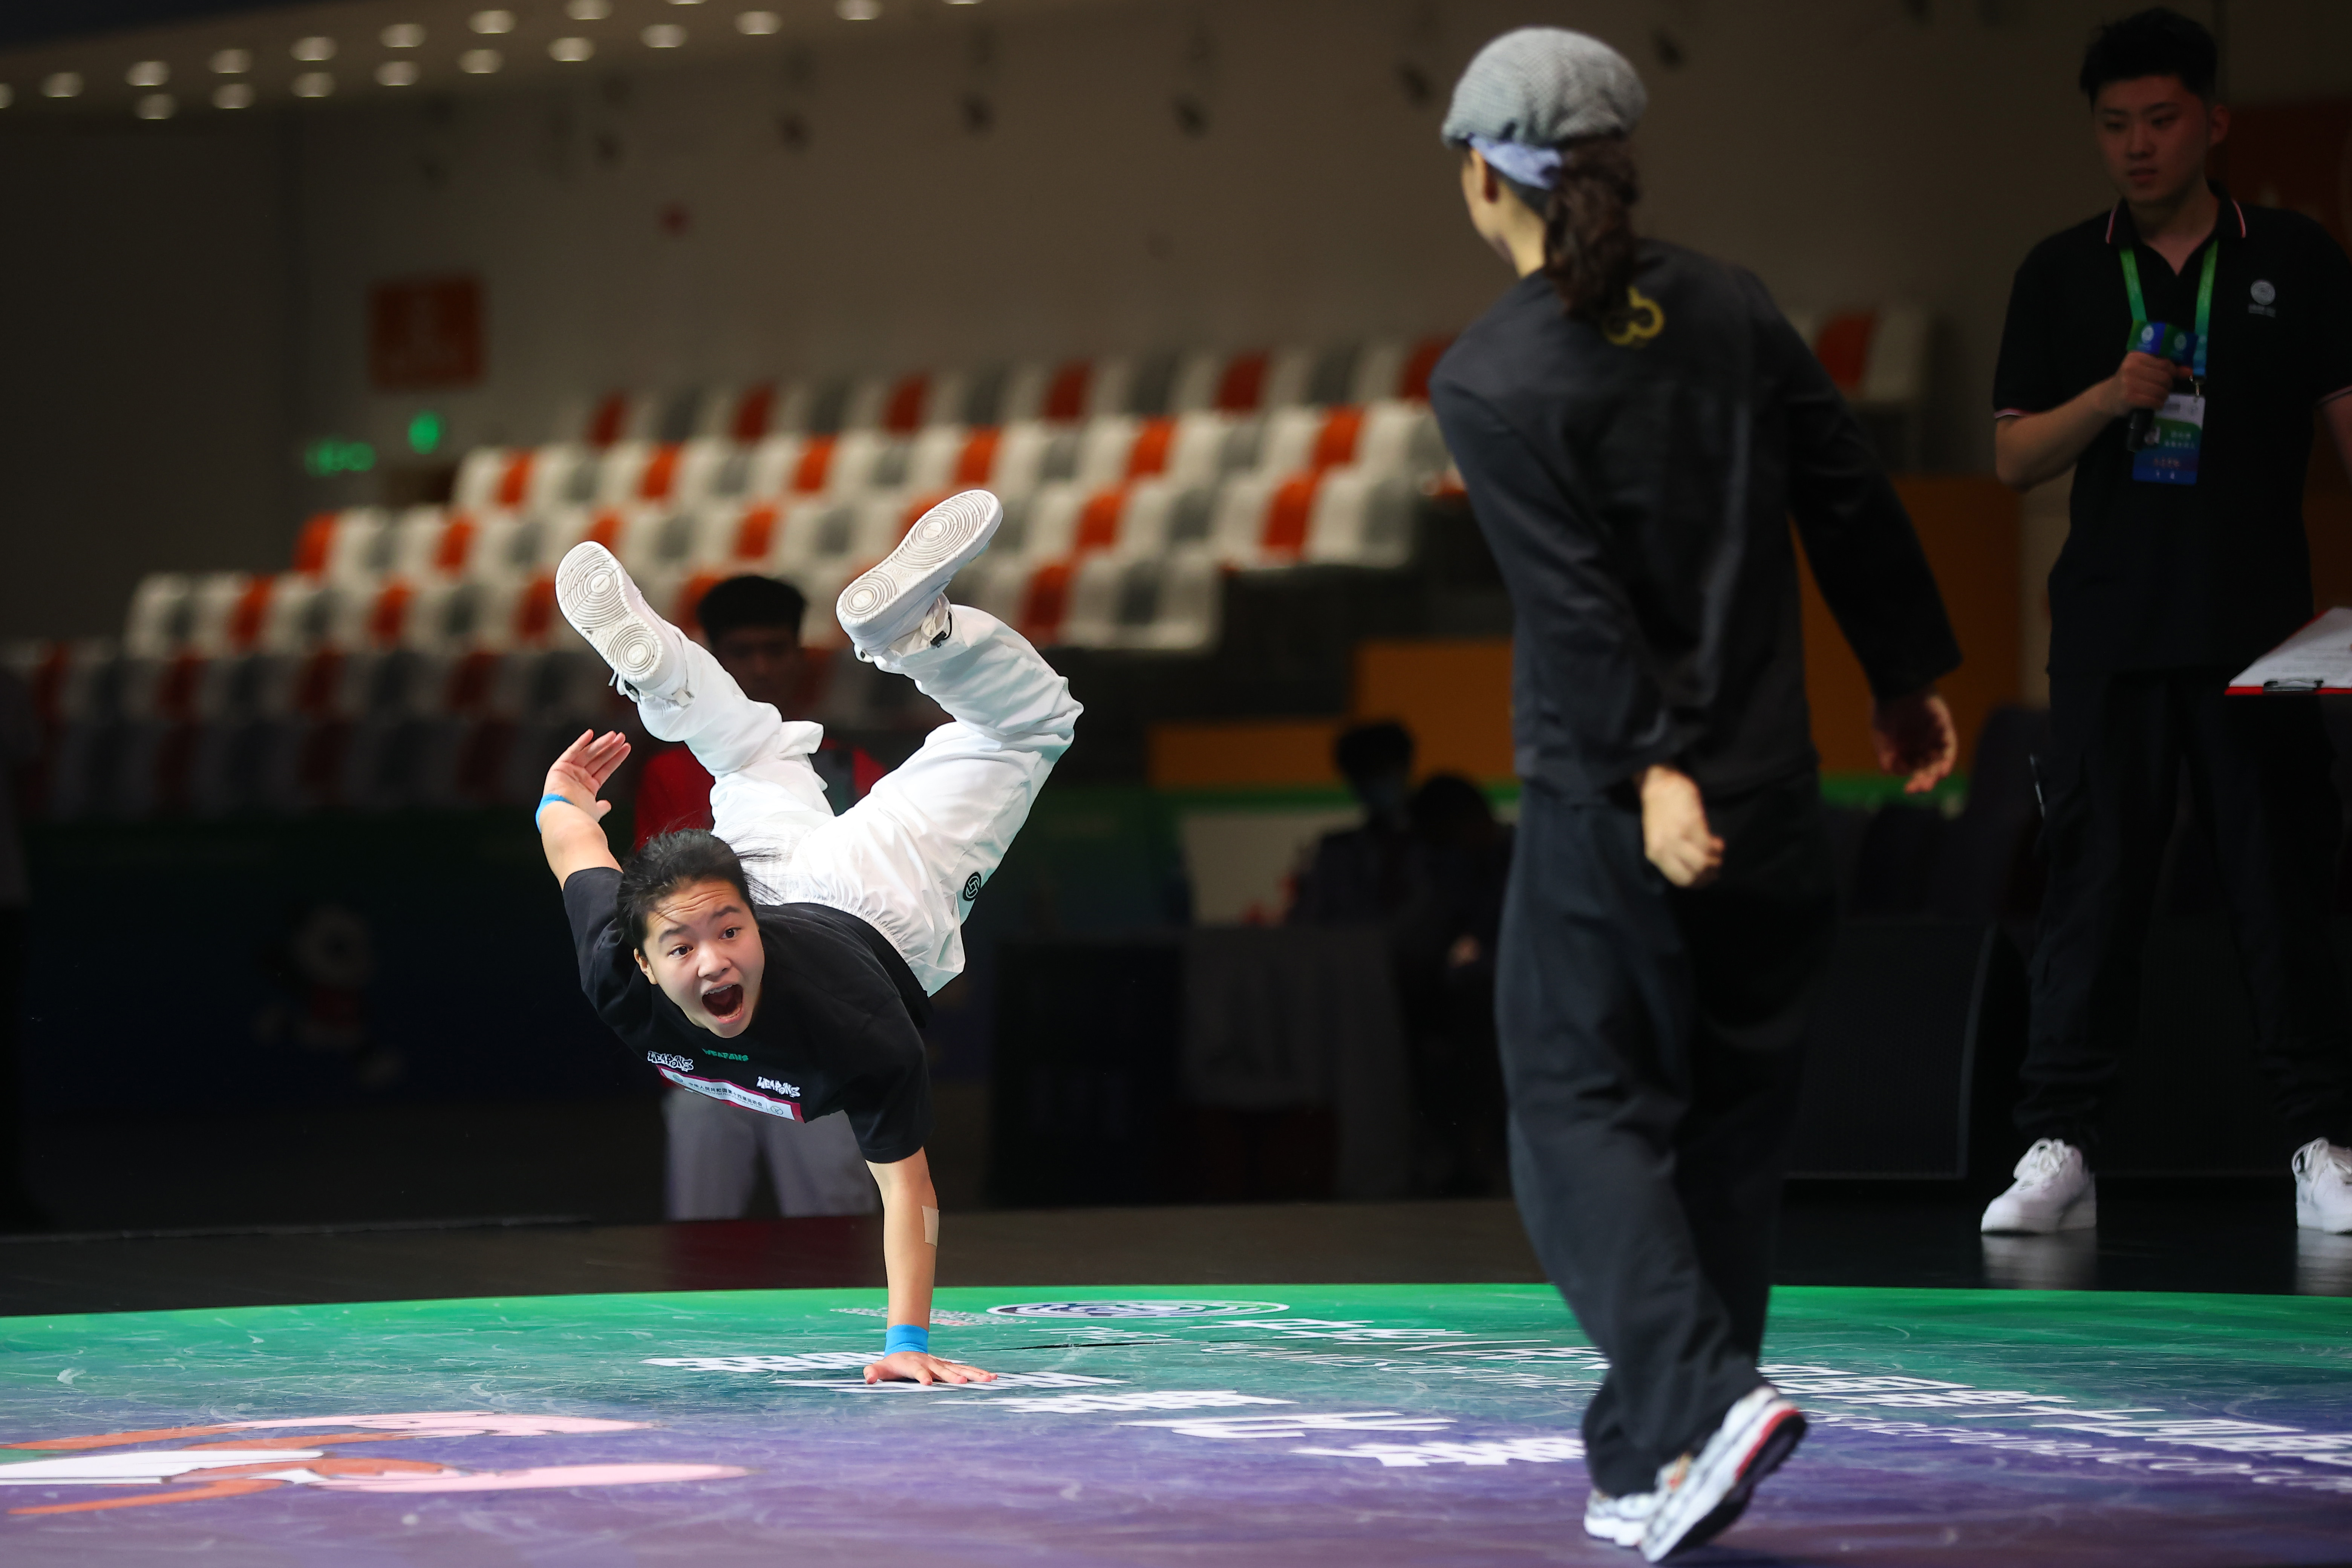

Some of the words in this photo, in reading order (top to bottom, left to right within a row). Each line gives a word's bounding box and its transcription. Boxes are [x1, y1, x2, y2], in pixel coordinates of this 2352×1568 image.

[648, 1050, 694, 1072] WEAPONS
[756, 1076, 801, 1097] WEAPONS
[1029, 1326, 1169, 1340] THE
[1201, 1346, 1426, 1367] GAMES
[1379, 1366, 1505, 1374] OF
[1453, 1372, 1601, 1389] THE
[1828, 1422, 2197, 1464] REPUBLIC
